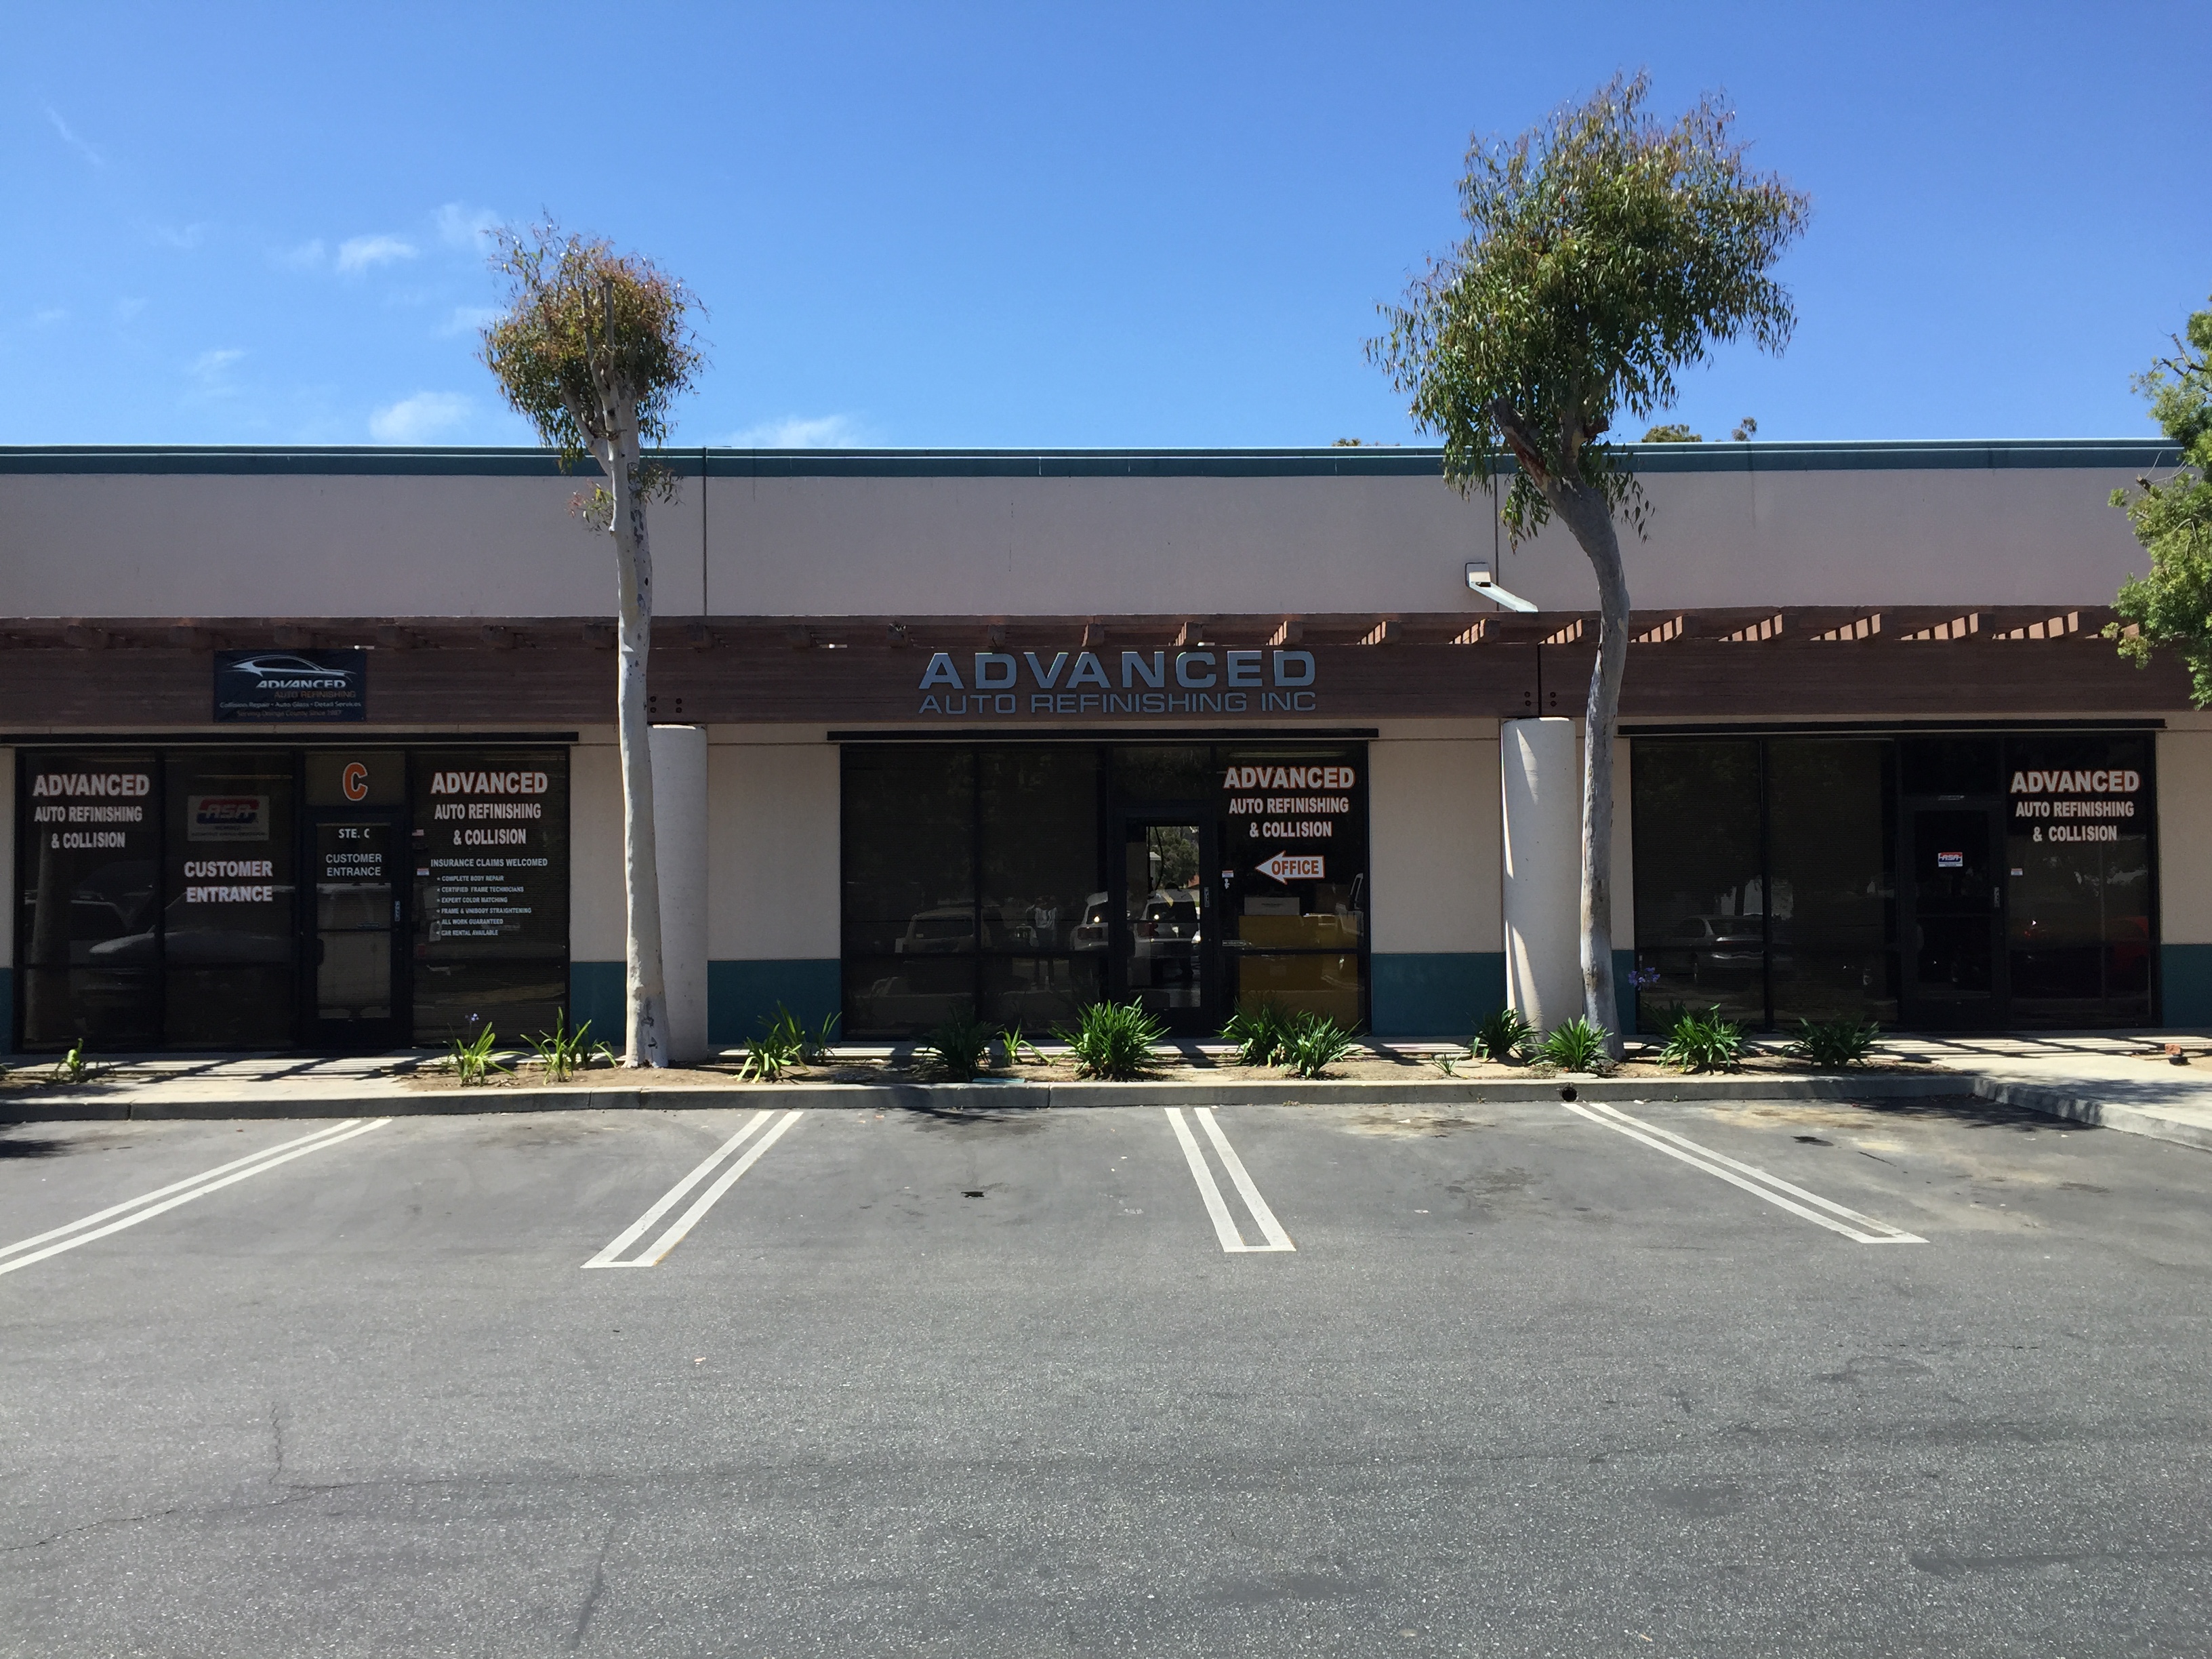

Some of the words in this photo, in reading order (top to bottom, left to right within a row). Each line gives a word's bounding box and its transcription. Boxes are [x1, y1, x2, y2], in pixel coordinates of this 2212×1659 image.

[918, 650, 1316, 690] ADVANCED
[255, 679, 346, 689] ADVANCED
[918, 693, 1016, 714] AUTO
[1031, 692, 1247, 714] REFINISHING
[1261, 691, 1316, 712] INC
[32, 773, 150, 797] ADVANCED
[342, 762, 368, 801] C
[430, 771, 548, 795] ADVANCED
[1223, 766, 1355, 790] ADVANCED
[2009, 770, 2141, 794] ADVANCED
[434, 803, 466, 820] AUTO
[468, 803, 541, 819] REFINISHING
[1228, 798, 1263, 814] AUTO
[1267, 796, 1349, 813] REFINISHING
[2015, 801, 2051, 817] AUTO
[2053, 800, 2135, 817] REFINISHING
[34, 806, 66, 822] AUTO
[68, 806, 143, 822] REFINISHING
[338, 828, 361, 839] STE.
[363, 828, 371, 839] C
[453, 829, 462, 846] &
[464, 828, 527, 845] COLLISION
[1249, 821, 1259, 838] &
[1262, 821, 1332, 838] COLLISION
[2032, 826, 2043, 842] &
[2048, 825, 2117, 842] COLLISION
[51, 832, 60, 848] &
[62, 832, 125, 848] COLLISION
[325, 853, 382, 863] CUSTOMER
[430, 859, 474, 867] INSURANCE
[476, 858, 504, 867] CLAIMS
[505, 858, 548, 867] WELCOMED
[184, 861, 274, 878] CUSTOMER
[326, 867, 382, 877] ENTRANCE
[1271, 860, 1319, 875] OFFICE
[186, 885, 273, 903] ENTRANCE
